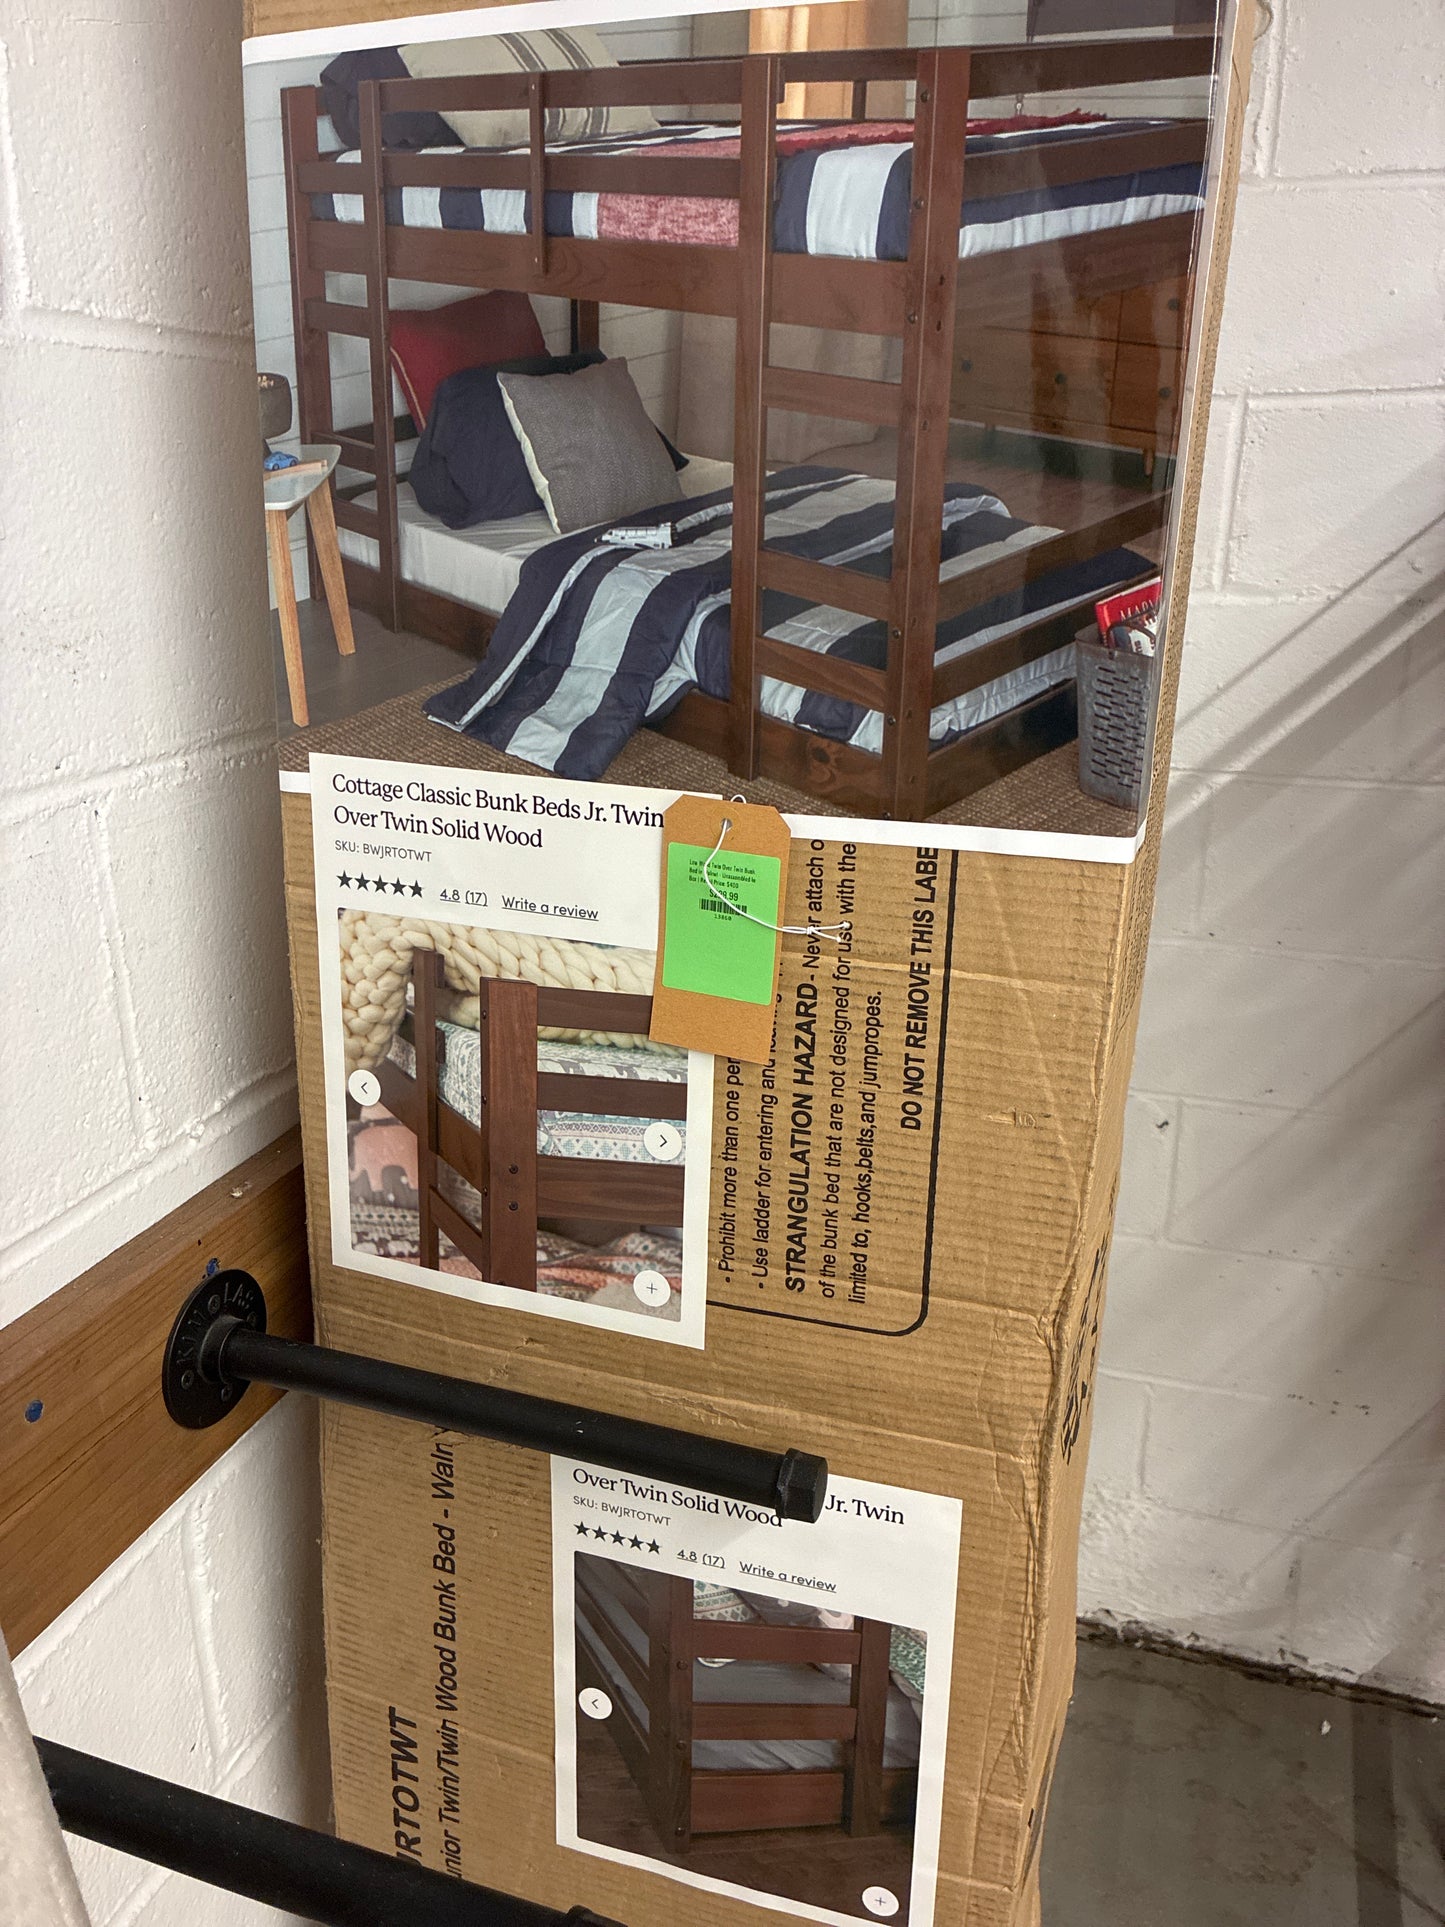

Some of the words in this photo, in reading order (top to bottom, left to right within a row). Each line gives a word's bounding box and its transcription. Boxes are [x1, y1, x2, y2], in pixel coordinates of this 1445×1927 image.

[332, 773, 403, 802] Cottage
[406, 782, 471, 807] Classic
[475, 789, 528, 814] Bunk
[532, 795, 581, 819] Beds
[584, 801, 607, 822] Jr.
[611, 803, 664, 828] Twin
[334, 805, 378, 828] Over
[381, 810, 428, 834] Twin
[431, 816, 480, 840] Solid
[484, 822, 543, 848] Wood
[334, 840, 360, 854] SKU:
[363, 843, 432, 862] BWJRTOTWT
[837, 842, 857, 872] the
[915, 847, 938, 903] LABE
[440, 888, 461, 902] 4.8
[465, 890, 488, 907] (17)
[502, 895, 537, 913] Write
[540, 903, 549, 914] a
[553, 904, 599, 920] review
[836, 877, 856, 915] with
[911, 909, 935, 953] THIS
[832, 955, 851, 981] for
[829, 985, 852, 1067] designed
[905, 962, 931, 1049] REMOVE
[859, 991, 884, 1089] jumpropes.
[726, 1057, 744, 1087] per
[785, 1092, 813, 1293] STRANGULATION
[805, 857, 824, 913] attach
[830, 1072, 846, 1098] not
[903, 1053, 925, 1095] NOT
[726, 1090, 740, 1121] one
[829, 1102, 844, 1131] are
[901, 1100, 923, 1130] DO
[721, 1128, 739, 1162] than
[756, 1093, 779, 1161] entering
[824, 1135, 842, 1168] that
[723, 1167, 738, 1208] more
[754, 1164, 772, 1188] for
[822, 1172, 841, 1205] bed
[752, 1190, 771, 1244] ladder
[820, 1208, 838, 1250] bunk
[718, 1212, 737, 1272] Prohibit
[853, 1228, 872, 1249] to,
[752, 1248, 769, 1278] Use
[819, 1253, 836, 1278] the
[848, 1252, 868, 1304] limited
[818, 1280, 836, 1299] of
[573, 1468, 618, 1492] Over
[620, 1478, 668, 1504] Twin
[671, 1490, 720, 1515] Solid
[573, 1495, 598, 1510] SKU:
[601, 1502, 671, 1526] BWJRTOTWT
[825, 1494, 848, 1513] Jr.
[852, 1498, 905, 1525] Twin
[432, 1523, 456, 1575] Bed
[677, 1549, 698, 1563] 4.8
[702, 1552, 726, 1569] (17)
[739, 1560, 775, 1579] Write
[778, 1572, 788, 1582] a
[791, 1574, 837, 1593] review
[433, 1579, 457, 1642] Bunk
[434, 1644, 459, 1711] Wood
[436, 1718, 460, 1824] Twin/Twin
